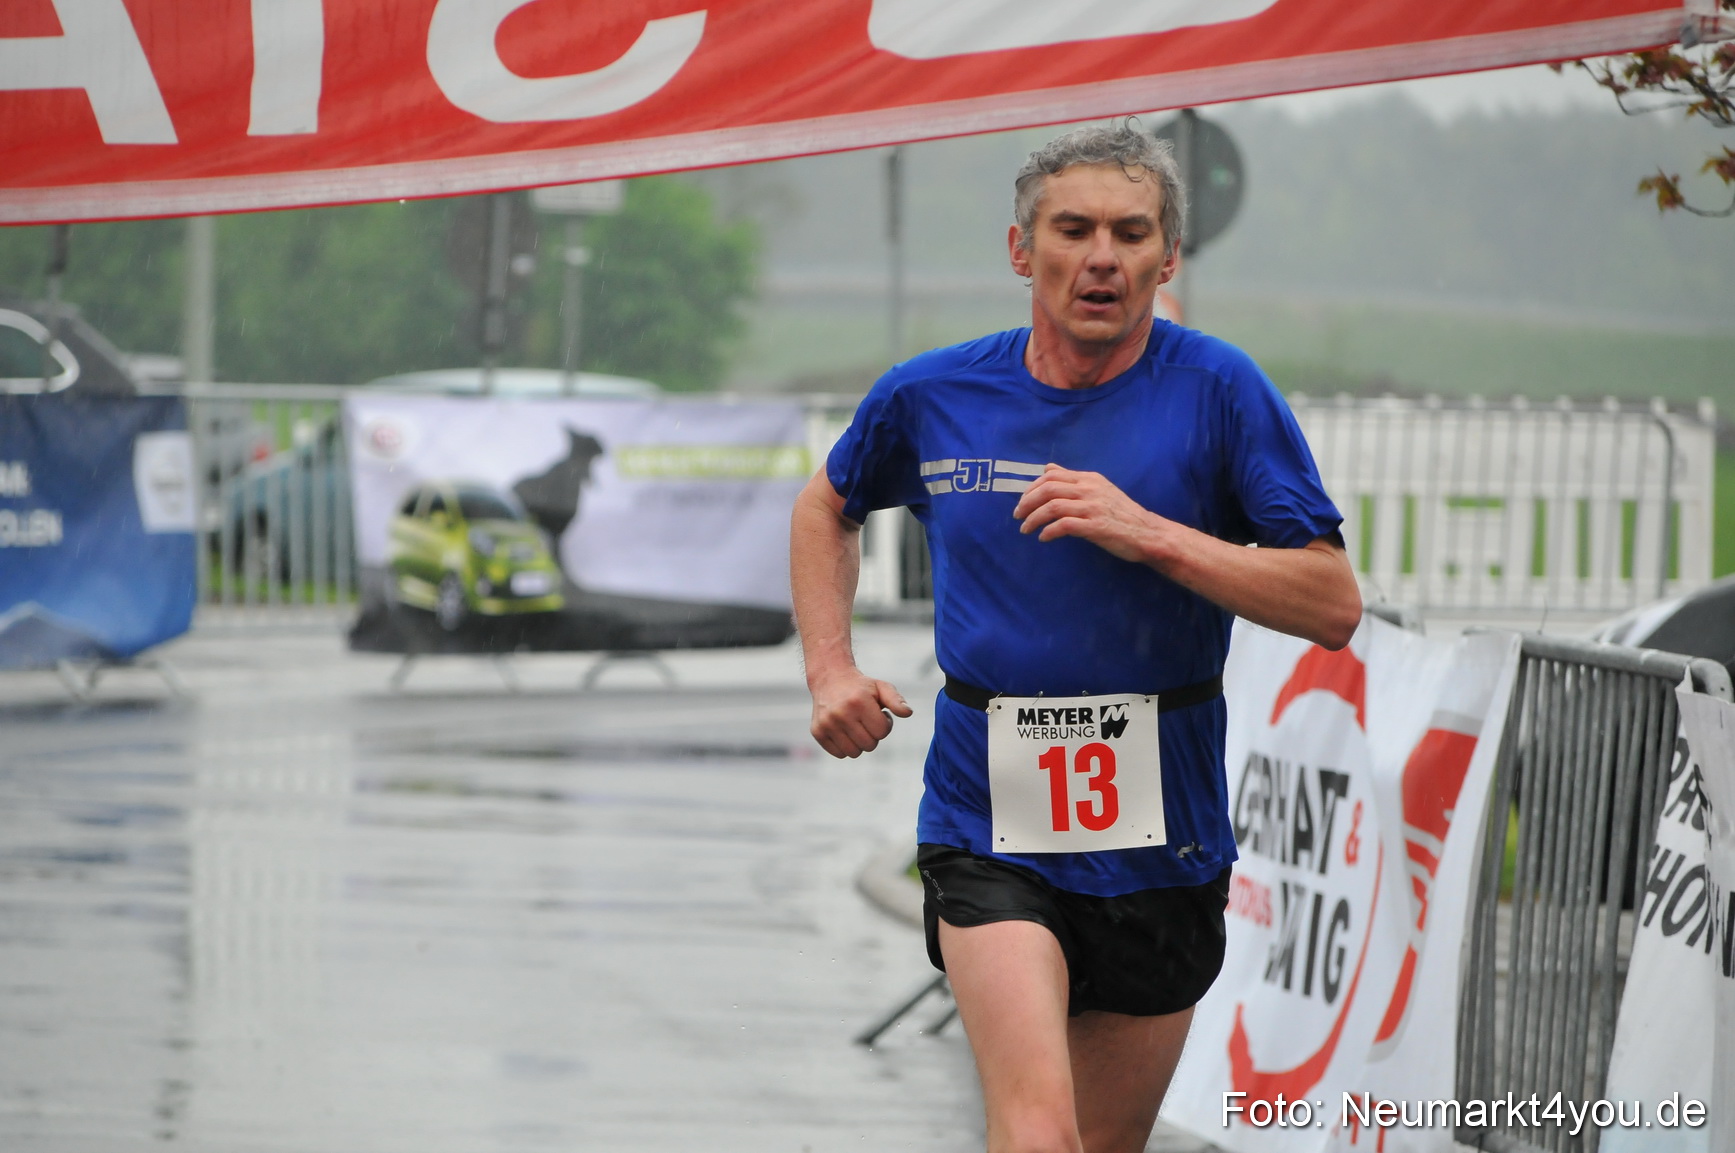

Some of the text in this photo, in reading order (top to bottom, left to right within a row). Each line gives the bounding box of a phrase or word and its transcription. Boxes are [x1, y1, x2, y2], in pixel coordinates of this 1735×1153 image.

[1017, 707, 1094, 726] MEYER
[1017, 726, 1096, 740] WERBUNG
[1038, 742, 1119, 832] 13
